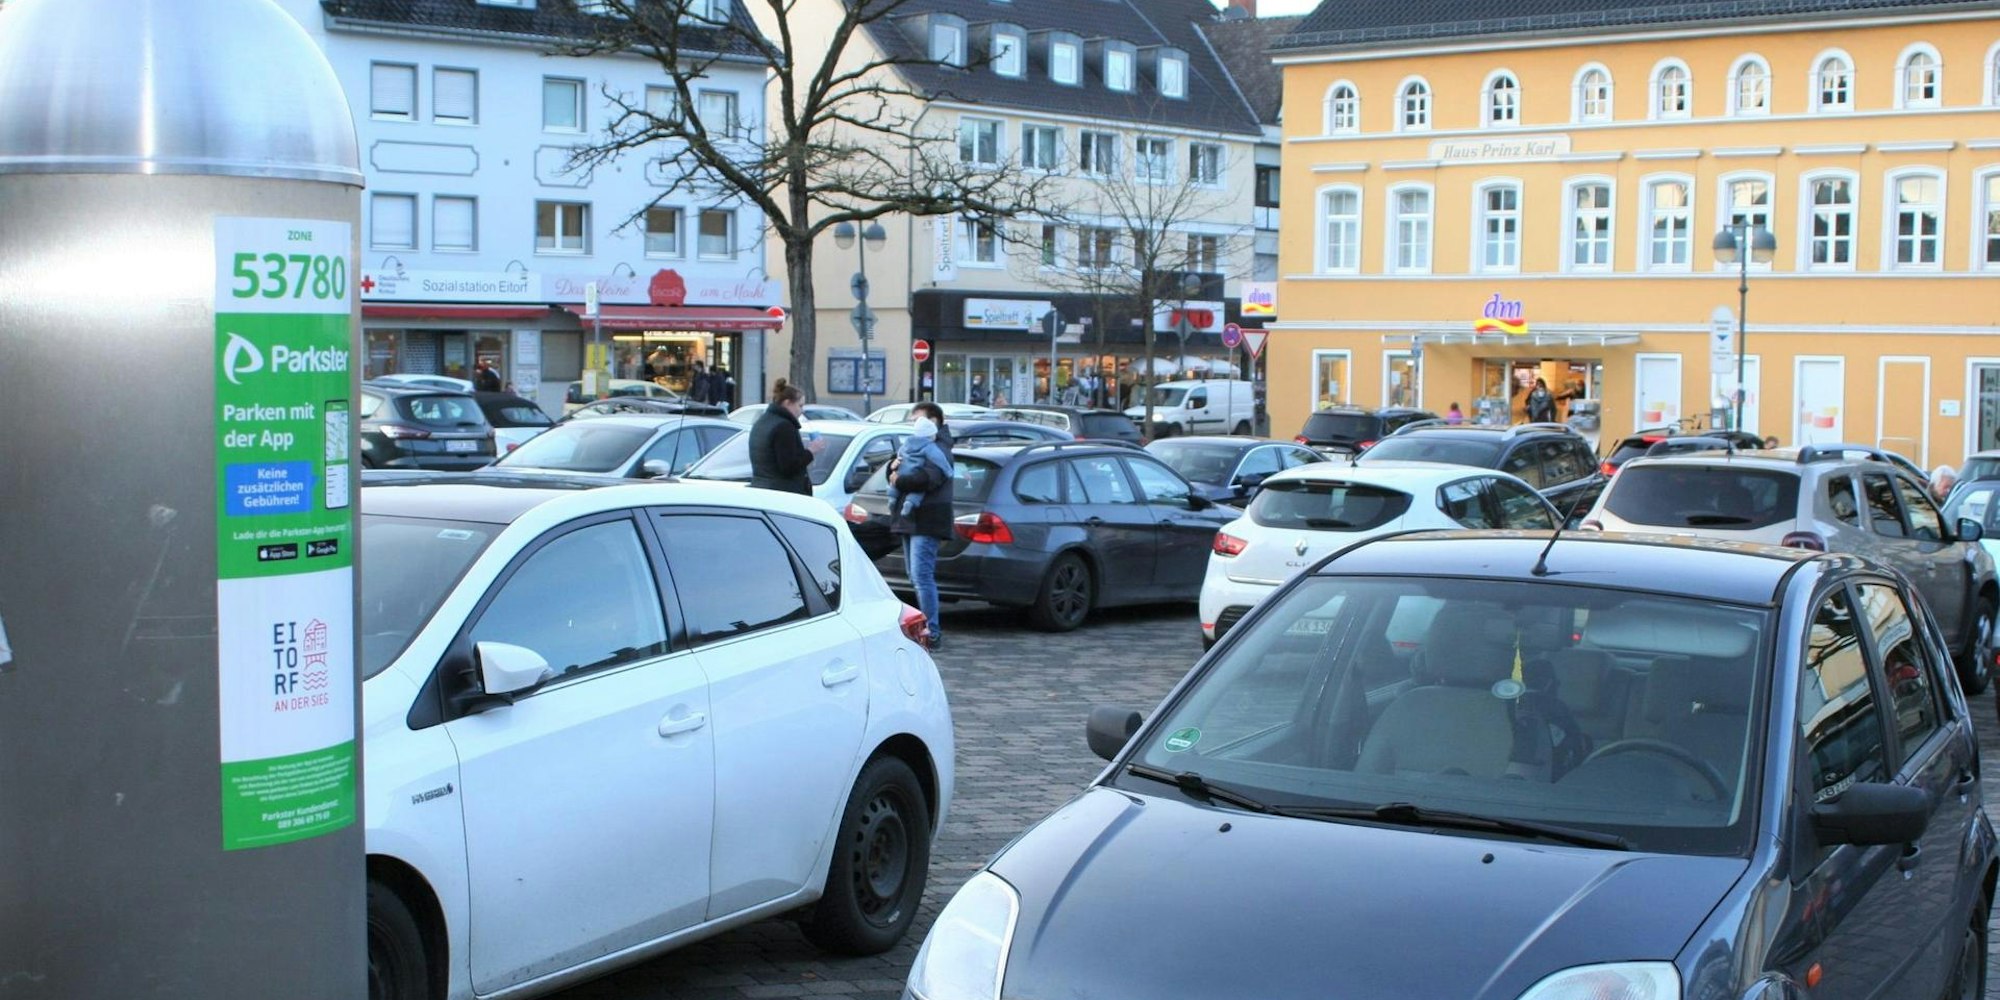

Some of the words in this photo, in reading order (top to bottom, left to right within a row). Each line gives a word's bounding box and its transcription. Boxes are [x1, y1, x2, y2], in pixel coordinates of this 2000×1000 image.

[1443, 145, 1478, 159] Haus
[1482, 143, 1521, 157] Prinz
[1526, 141, 1556, 155] Karl
[288, 230, 312, 241] ZONE
[232, 252, 345, 300] 53780
[499, 281, 528, 293] Eitorf
[1484, 293, 1522, 318] dm
[271, 345, 348, 373] Parkster
[223, 404, 287, 422] Parken
[290, 402, 315, 420] mit
[224, 430, 256, 448] der
[260, 430, 294, 450] App
[257, 467, 288, 479] Keine
[237, 481, 304, 494] zusätzlichen
[243, 494, 300, 508] Gebühren!
[233, 531, 254, 540] Lade
[273, 621, 296, 645] EI
[273, 647, 298, 670] TO
[274, 672, 299, 695] RF
[275, 700, 289, 712] AN
[291, 697, 310, 710] DER
[311, 693, 329, 707] SIEG
